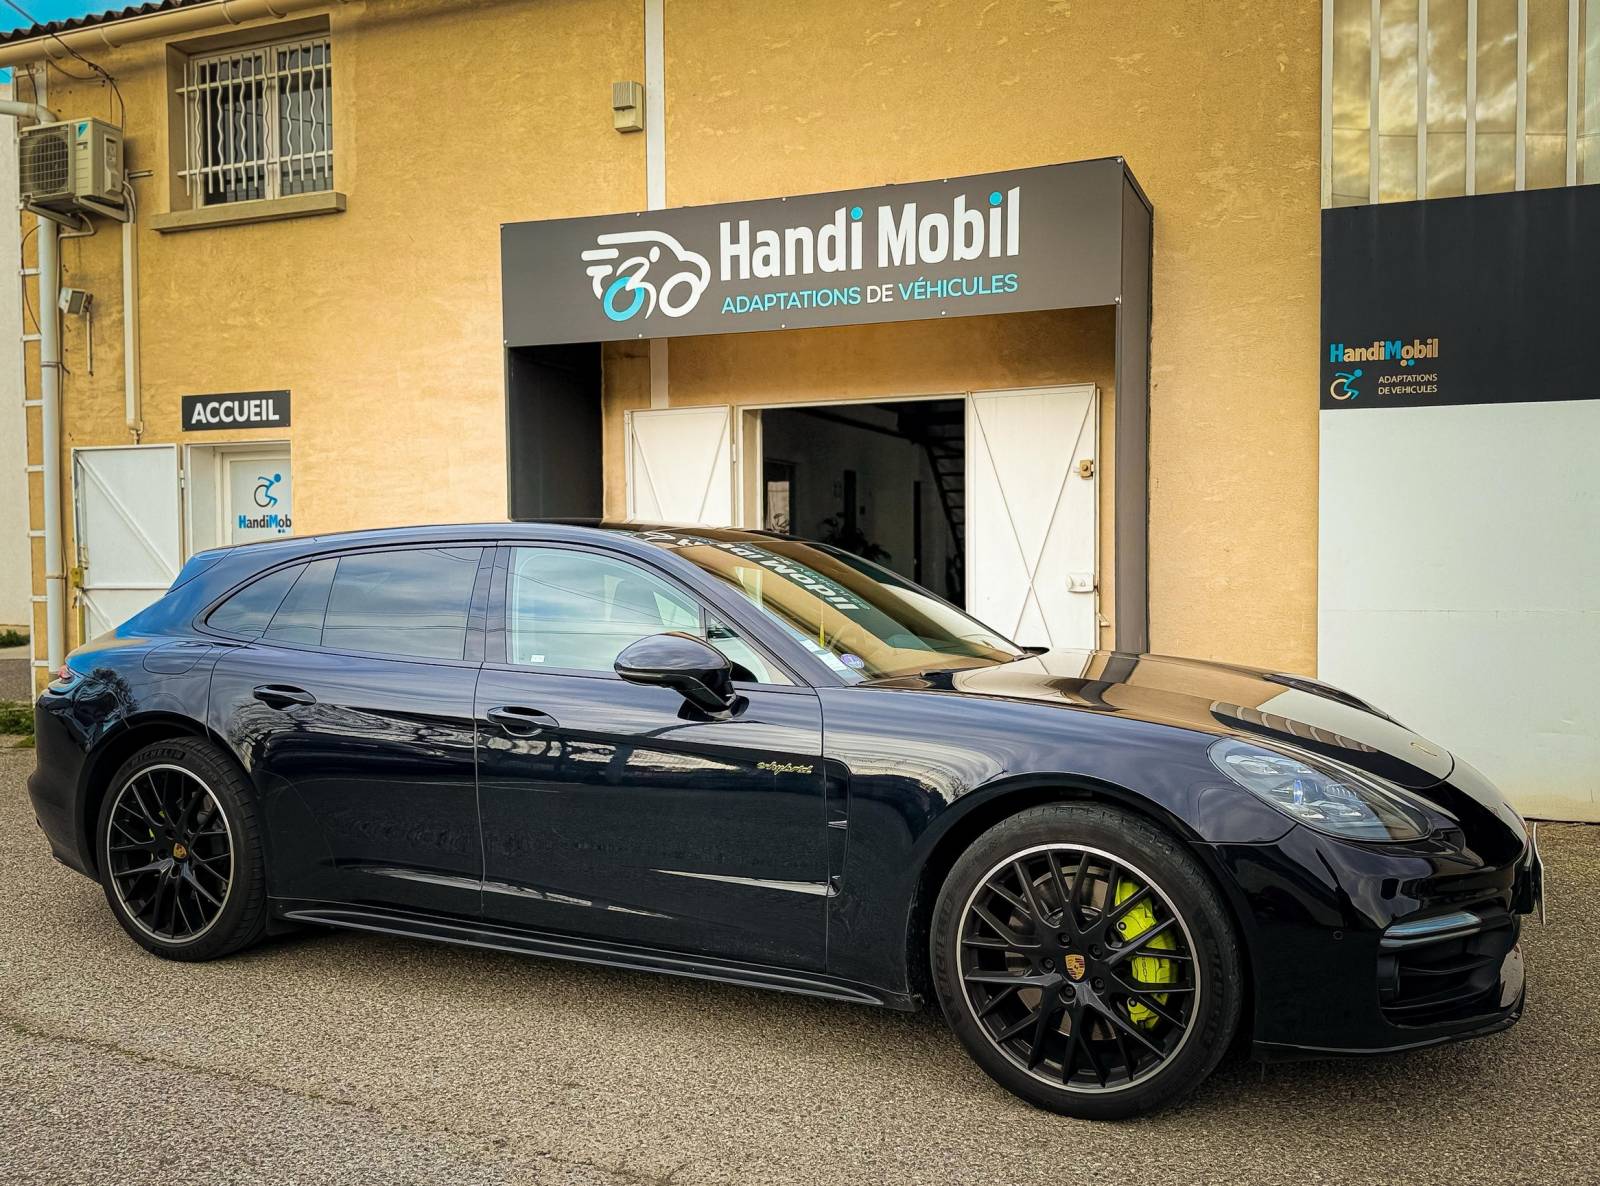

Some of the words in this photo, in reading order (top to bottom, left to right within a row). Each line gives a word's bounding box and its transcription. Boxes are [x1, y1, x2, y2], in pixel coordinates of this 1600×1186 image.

[719, 206, 863, 282] Handi
[877, 186, 1020, 268] Mobil
[721, 286, 861, 314] ADAPTATIONS
[866, 284, 893, 304] DE
[898, 273, 1018, 301] VÉHICULES
[1329, 338, 1439, 363] HandiMobil
[1378, 373, 1438, 384] ADAPTATIONS
[1378, 386, 1391, 395] DE
[1391, 384, 1438, 394] VEHICULES
[191, 399, 280, 424] ACCUEIL
